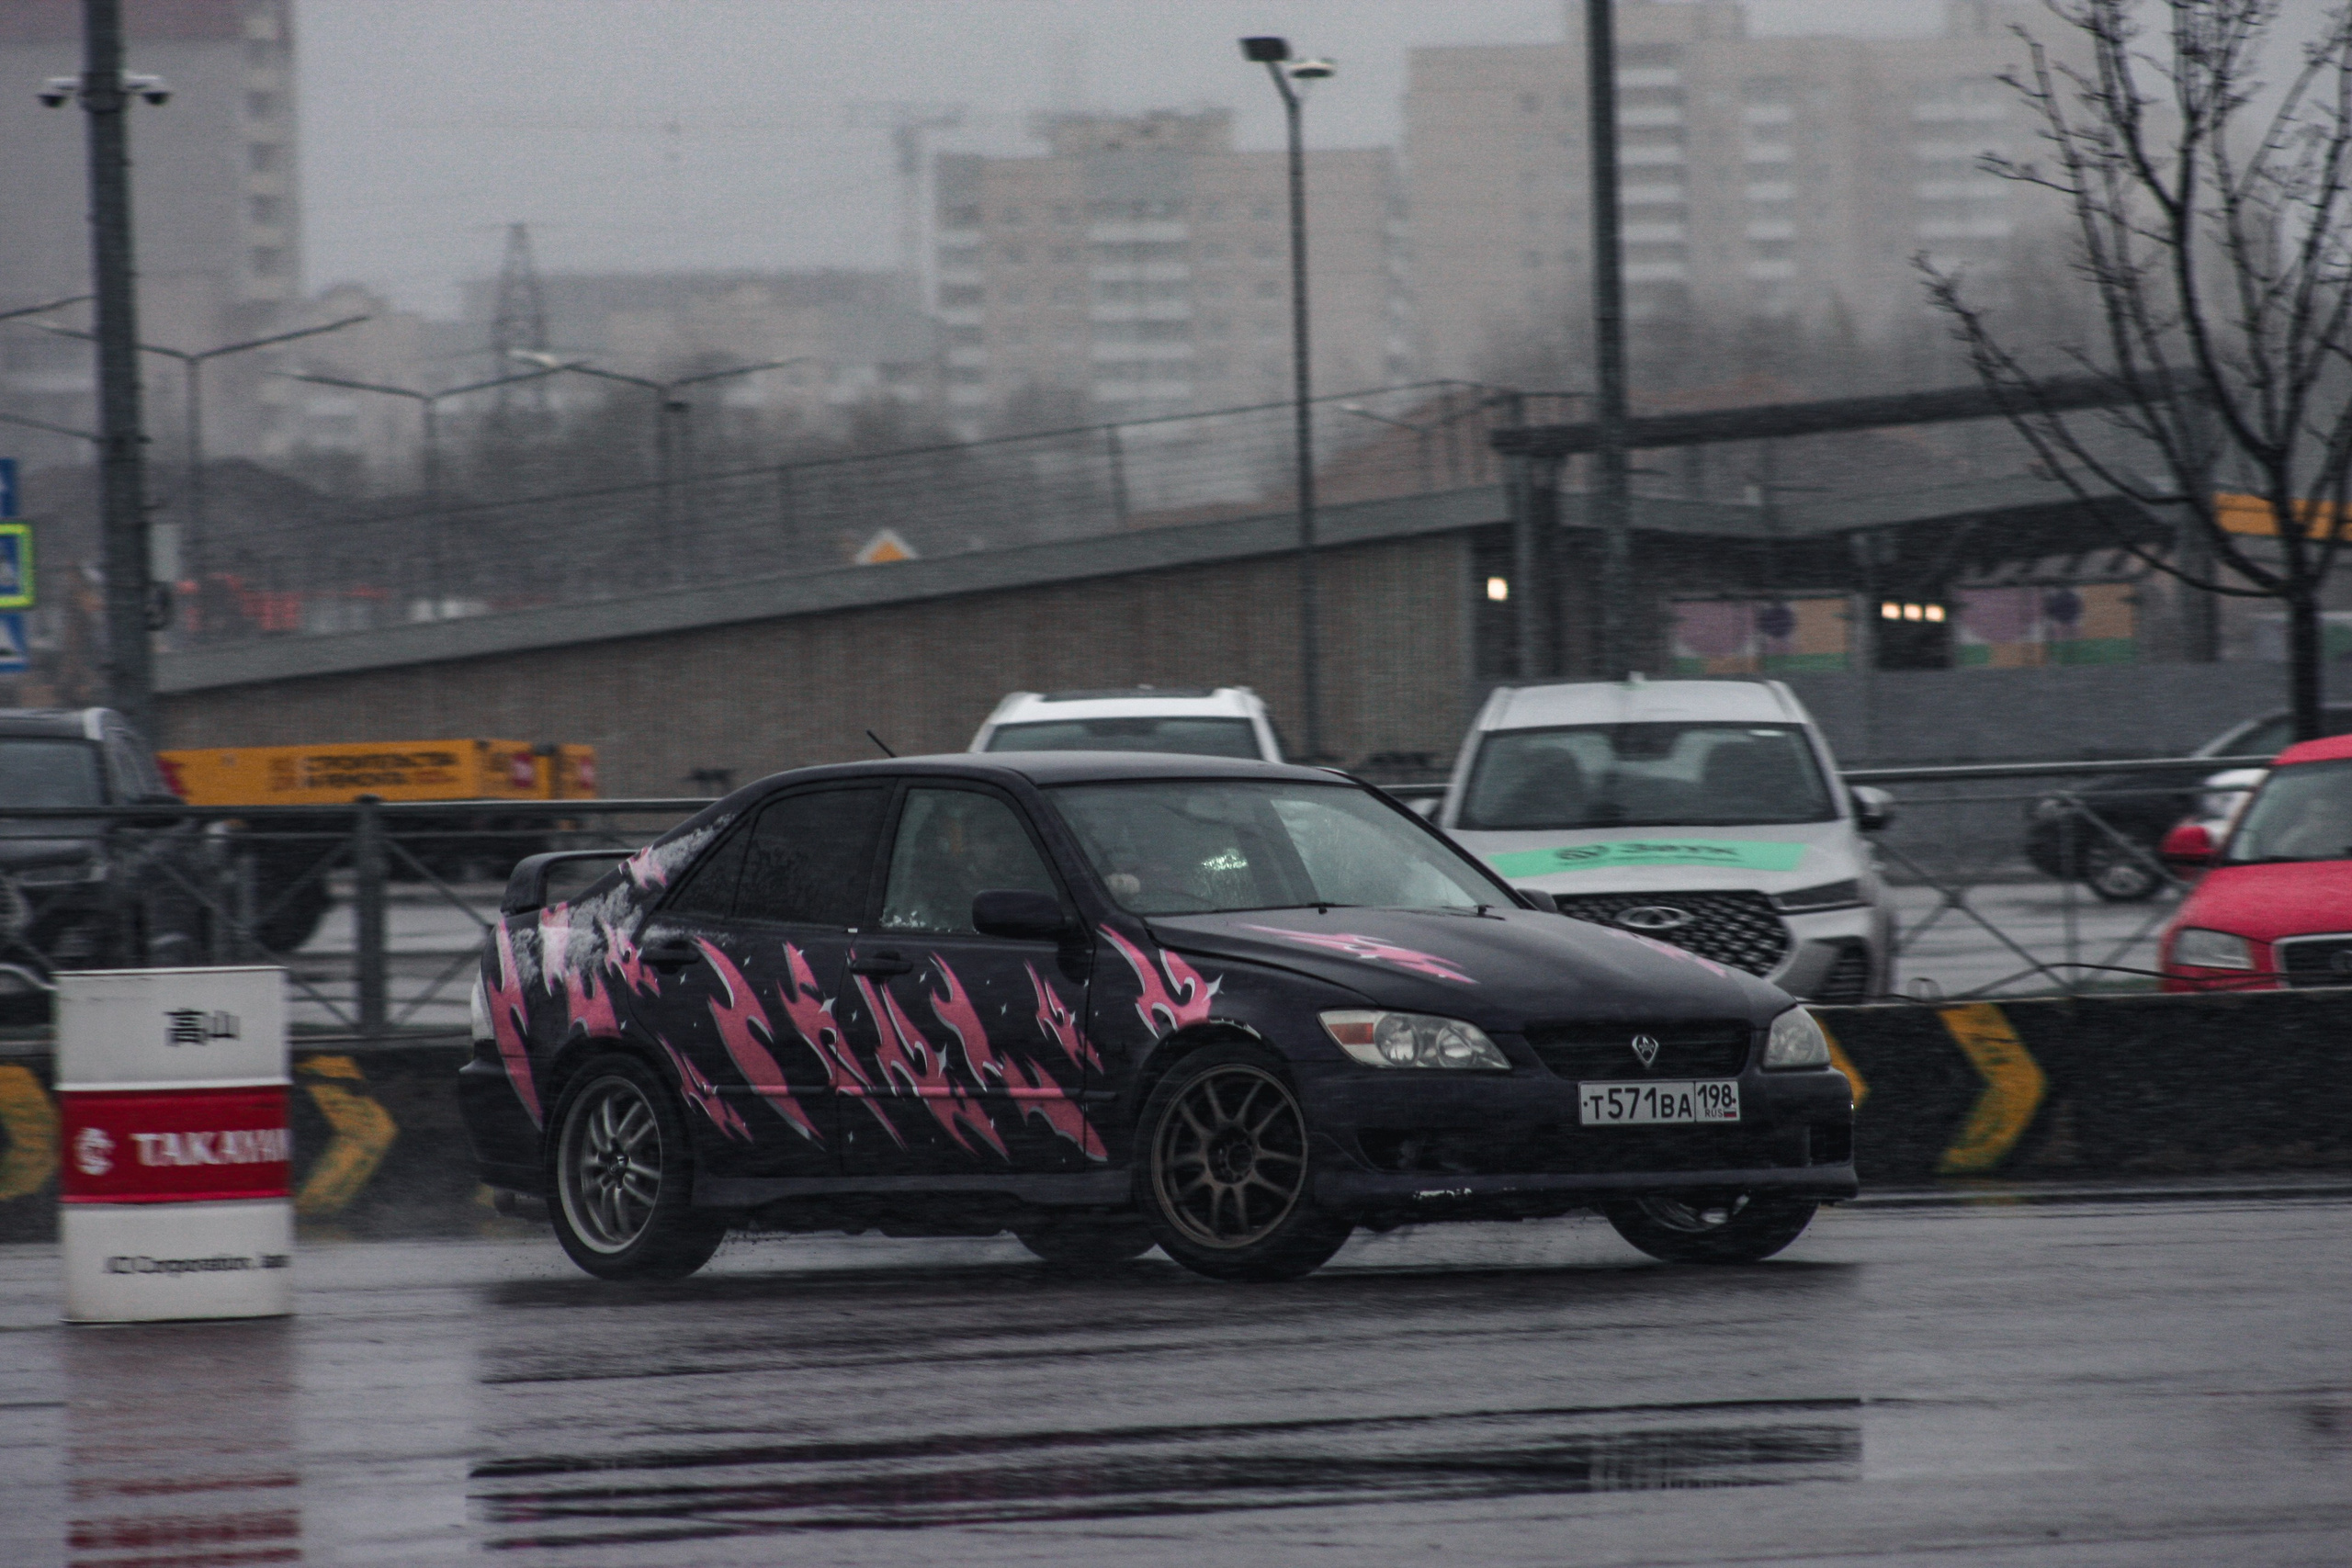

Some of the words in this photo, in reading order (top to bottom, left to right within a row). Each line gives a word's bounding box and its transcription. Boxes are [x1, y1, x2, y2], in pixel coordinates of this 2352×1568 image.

[1589, 1087, 1692, 1120] Т571ВА
[1698, 1084, 1732, 1109] 198
[1705, 1108, 1724, 1118] RUS
